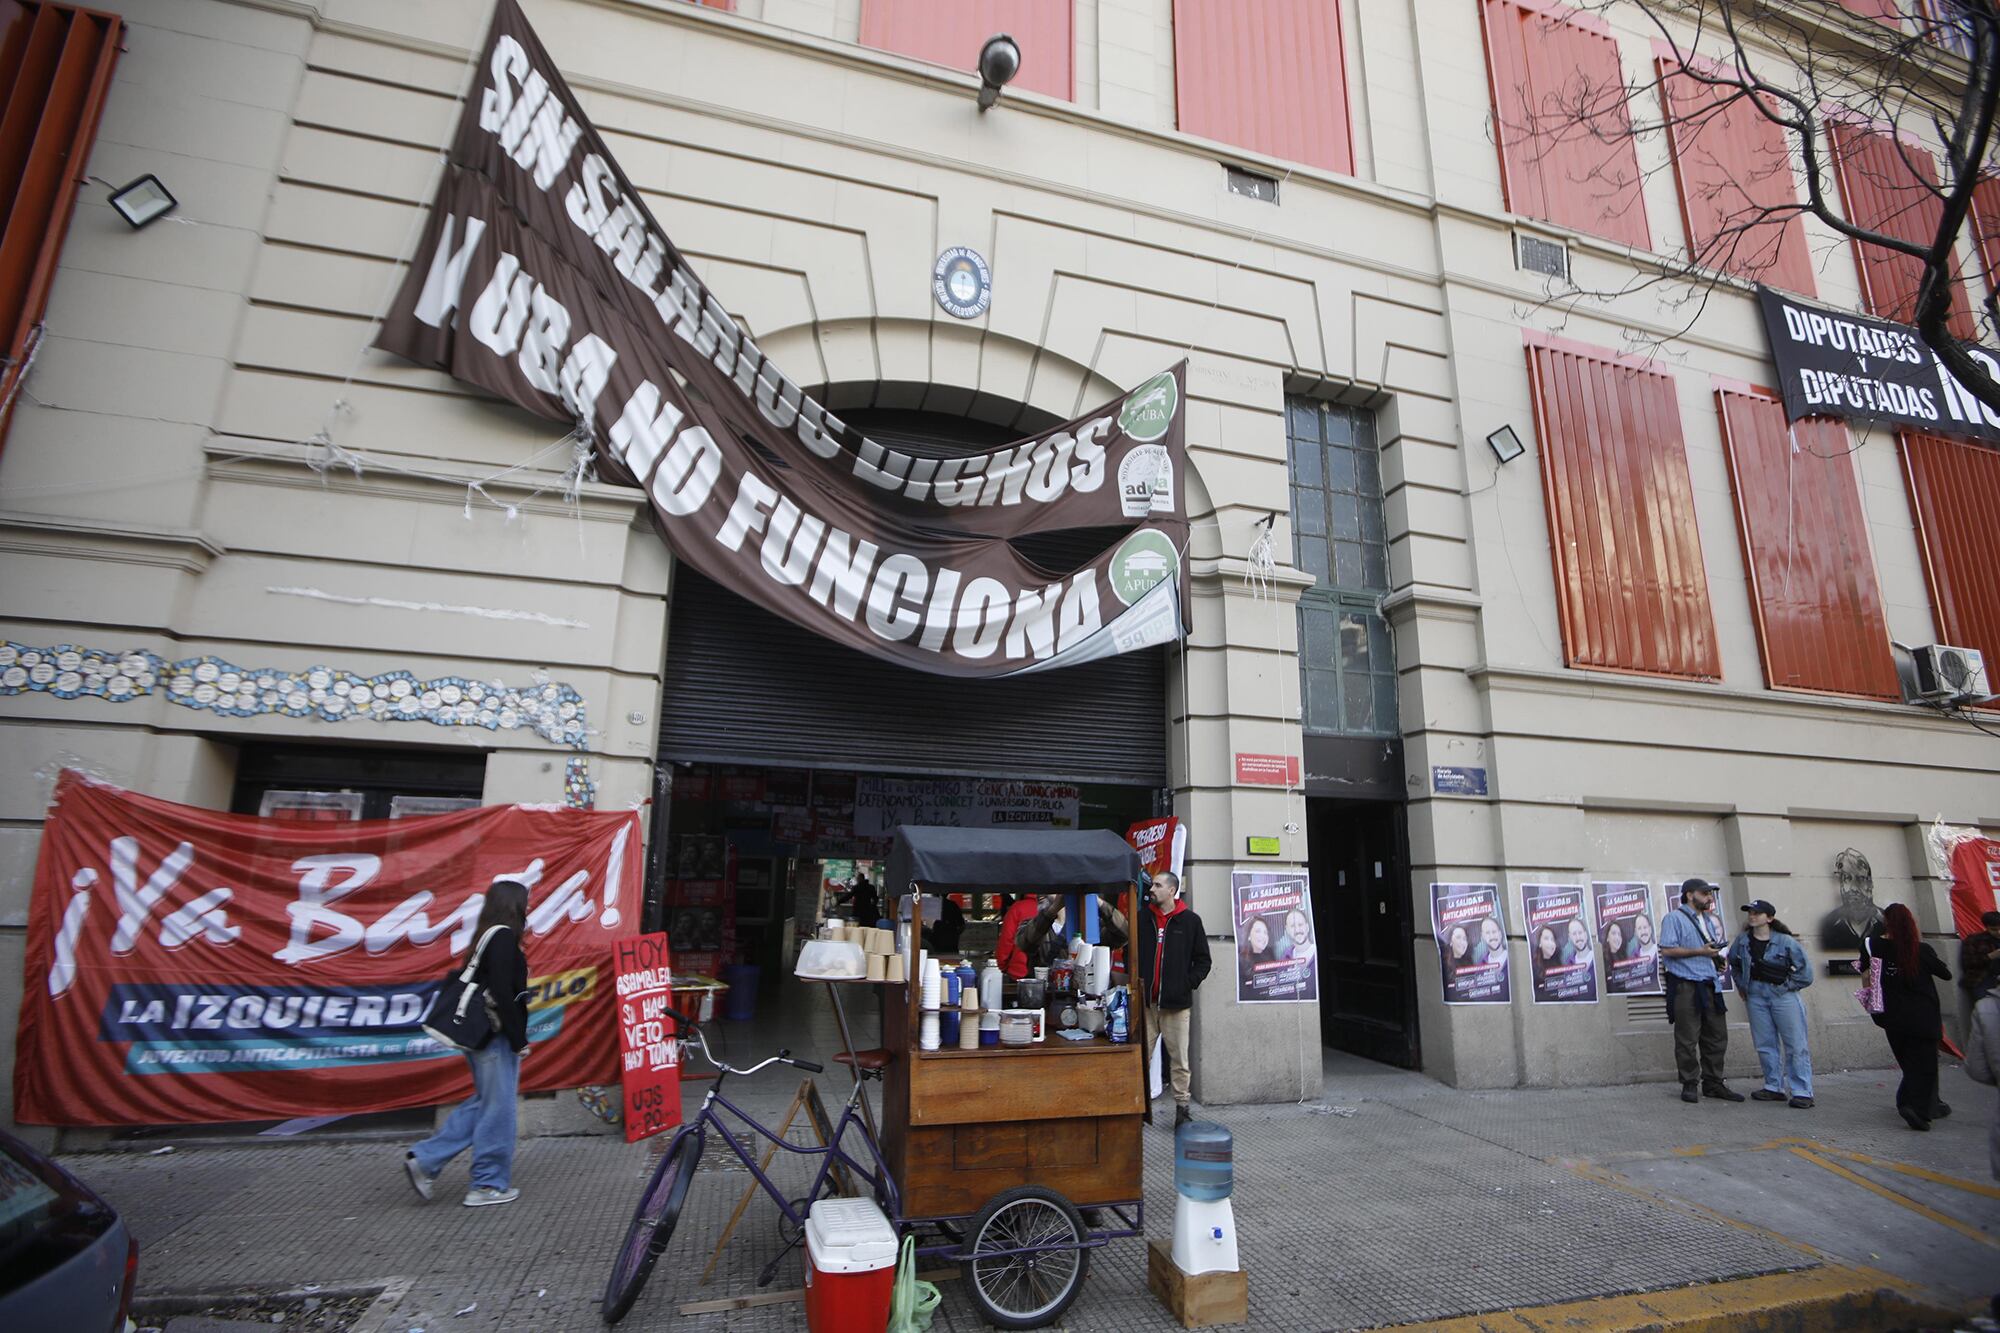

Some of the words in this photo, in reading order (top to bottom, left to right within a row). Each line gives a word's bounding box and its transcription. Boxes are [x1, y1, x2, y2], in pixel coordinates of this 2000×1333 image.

[480, 34, 582, 192] SIN
[565, 153, 845, 458] SALARIOS
[852, 416, 1112, 507] DIGNOS
[1782, 304, 1922, 364] DIPUTADOS
[1857, 356, 1867, 373] Y
[1800, 368, 1939, 421] DIPUTADAS
[470, 250, 619, 440] UBA
[608, 379, 722, 516] NO
[715, 471, 1102, 659] FUNCIONA
[1243, 896, 1300, 912] ANTICAPITALISTA
[1260, 887, 1284, 898] SALIDA
[49, 835, 242, 1000] ¡Ya
[620, 938, 665, 972] HOY
[616, 966, 672, 996] ASAMBLEA
[118, 999, 165, 1024] LA
[642, 995, 668, 1020] HAY
[625, 1021, 664, 1050] VETO
[231, 1043, 379, 1062] ANTICAPITALISTA
[646, 1040, 678, 1066] TOMA
[632, 1085, 664, 1112] UJS
